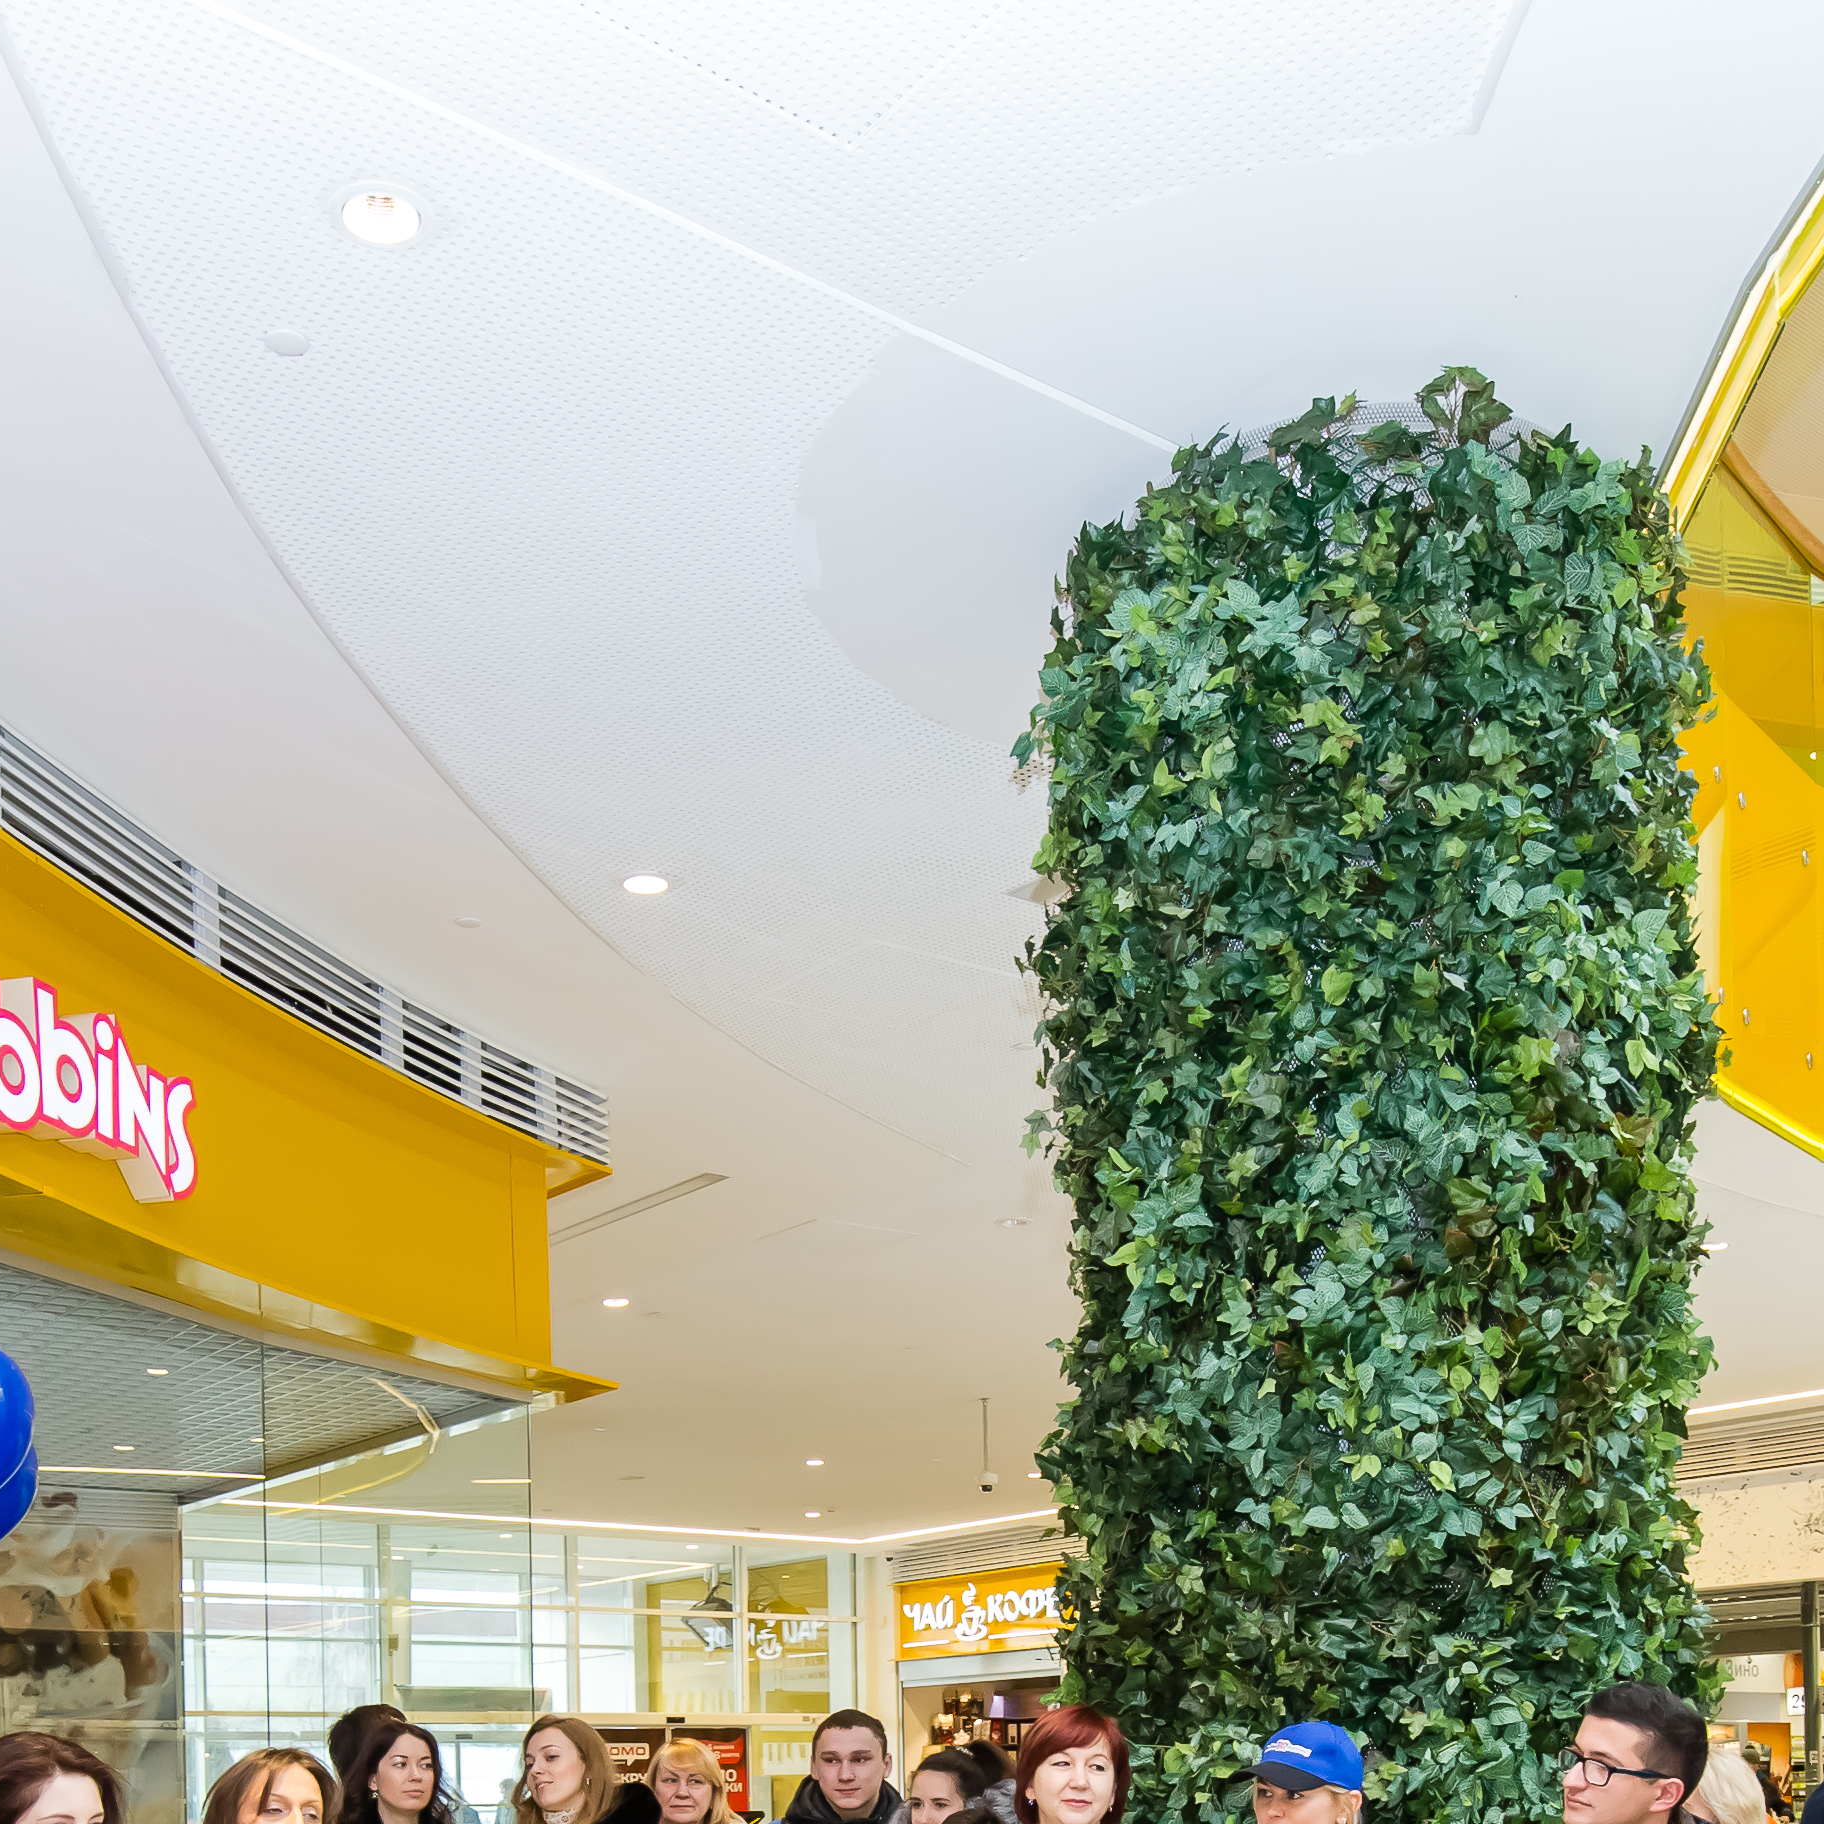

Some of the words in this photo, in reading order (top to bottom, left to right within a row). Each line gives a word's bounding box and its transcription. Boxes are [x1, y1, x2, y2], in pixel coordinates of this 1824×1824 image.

[902, 1594, 954, 1631] ЧАЙ
[986, 1586, 1060, 1623] КОФЕ
[608, 1745, 647, 1756] OMO
